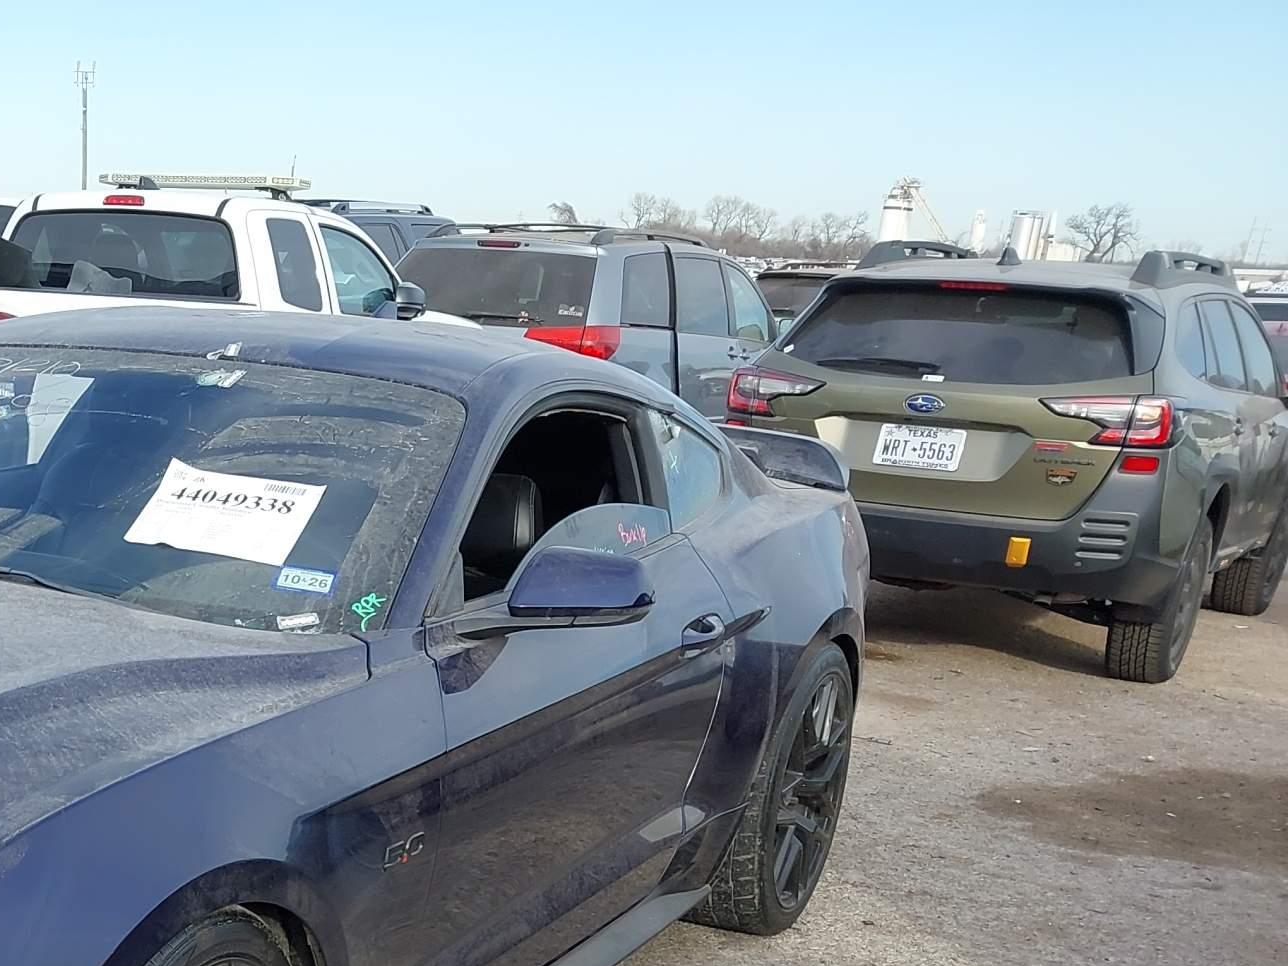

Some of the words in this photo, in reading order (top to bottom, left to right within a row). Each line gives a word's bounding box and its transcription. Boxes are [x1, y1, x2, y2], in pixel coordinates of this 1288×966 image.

[908, 429, 938, 439] TEXAS
[882, 438, 910, 457] WRT
[918, 441, 956, 462] 5563
[171, 487, 296, 514] 44049338
